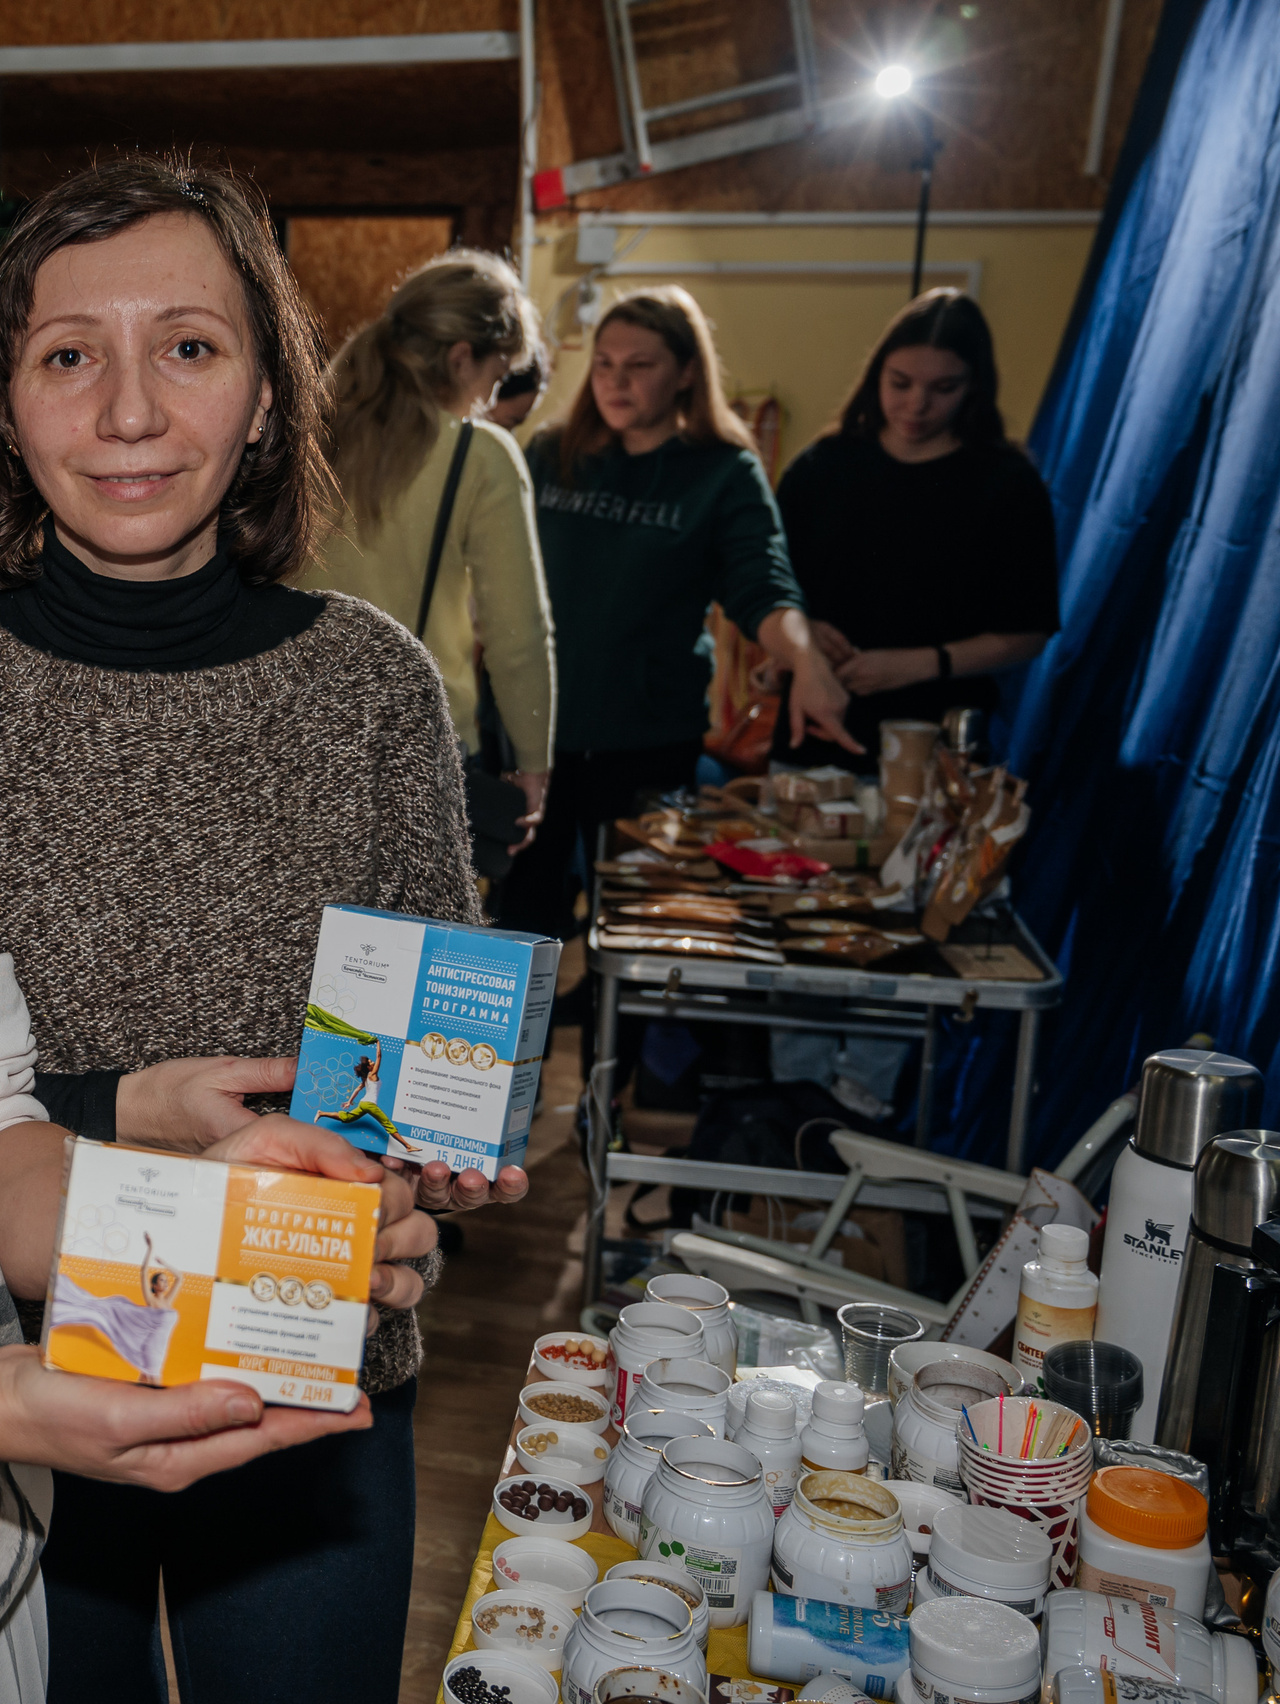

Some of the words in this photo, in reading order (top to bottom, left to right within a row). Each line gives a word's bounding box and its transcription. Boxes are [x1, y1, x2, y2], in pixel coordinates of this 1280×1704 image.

[427, 964, 516, 992] АНТИСТРЕССОВАЯ
[425, 980, 513, 1008] ТОНИЗИРУЮЩАЯ
[422, 997, 509, 1024] ПРОГРАММА
[410, 1126, 432, 1141] КУРС
[433, 1132, 488, 1154] ПРОГРАММЫ
[436, 1149, 449, 1163] 15
[452, 1153, 485, 1172] ДНЕЙ
[244, 1206, 356, 1237] ПРОГРАММА
[241, 1225, 353, 1261] ЖКТ-УЛЬТРА
[238, 1354, 266, 1371] КУРС
[267, 1359, 337, 1381] ПРОГРАММЫ
[278, 1381, 296, 1397] 42
[301, 1383, 333, 1402] ДНЯ
